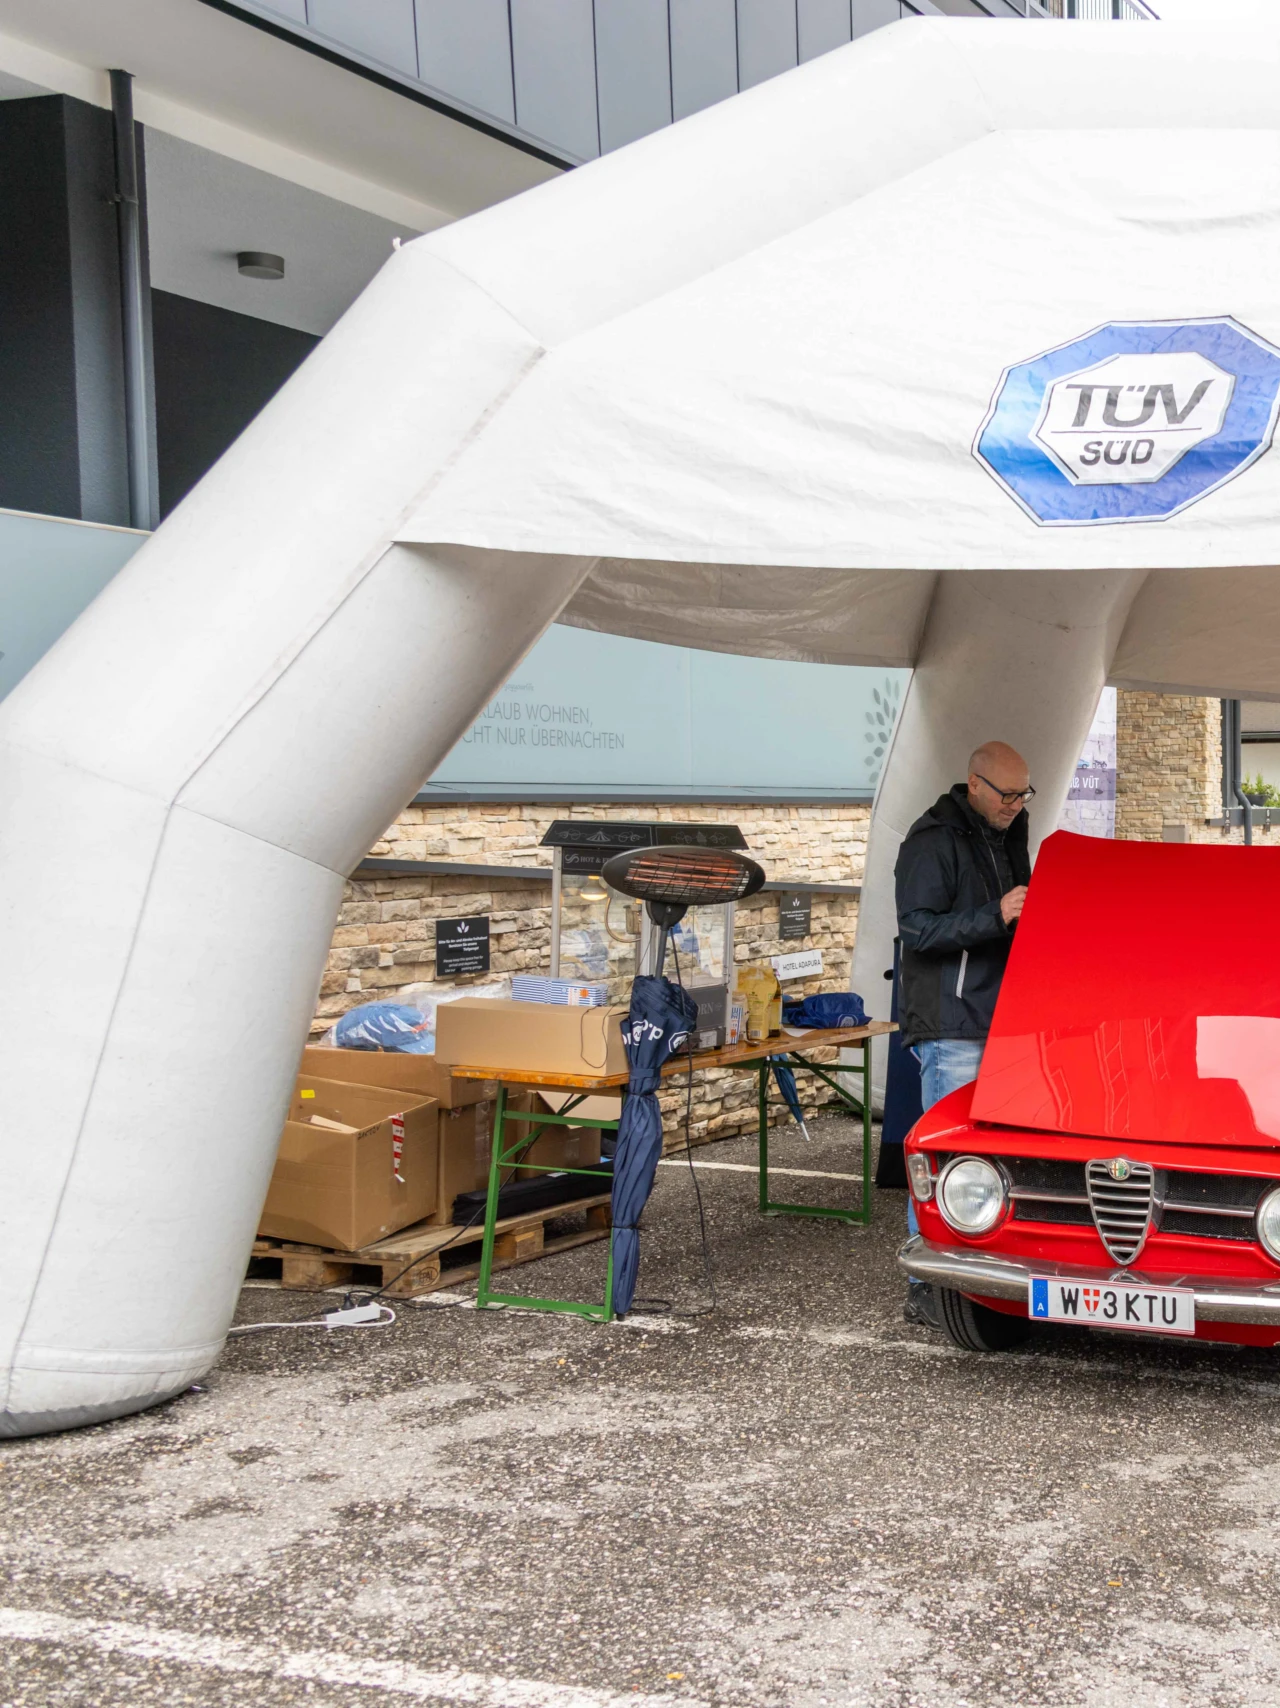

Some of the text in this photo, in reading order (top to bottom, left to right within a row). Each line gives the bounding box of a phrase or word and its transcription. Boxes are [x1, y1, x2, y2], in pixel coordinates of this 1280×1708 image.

[1065, 379, 1216, 428] TÜV
[1079, 438, 1156, 466] SÜD
[525, 703, 593, 727] WOHNEN,
[496, 726, 527, 746] NUR
[531, 724, 625, 749] ÜBERNACHTEN
[782, 959, 821, 972] HOTEL ADAPURA
[1037, 1286, 1177, 1325] A W 3 KTU
